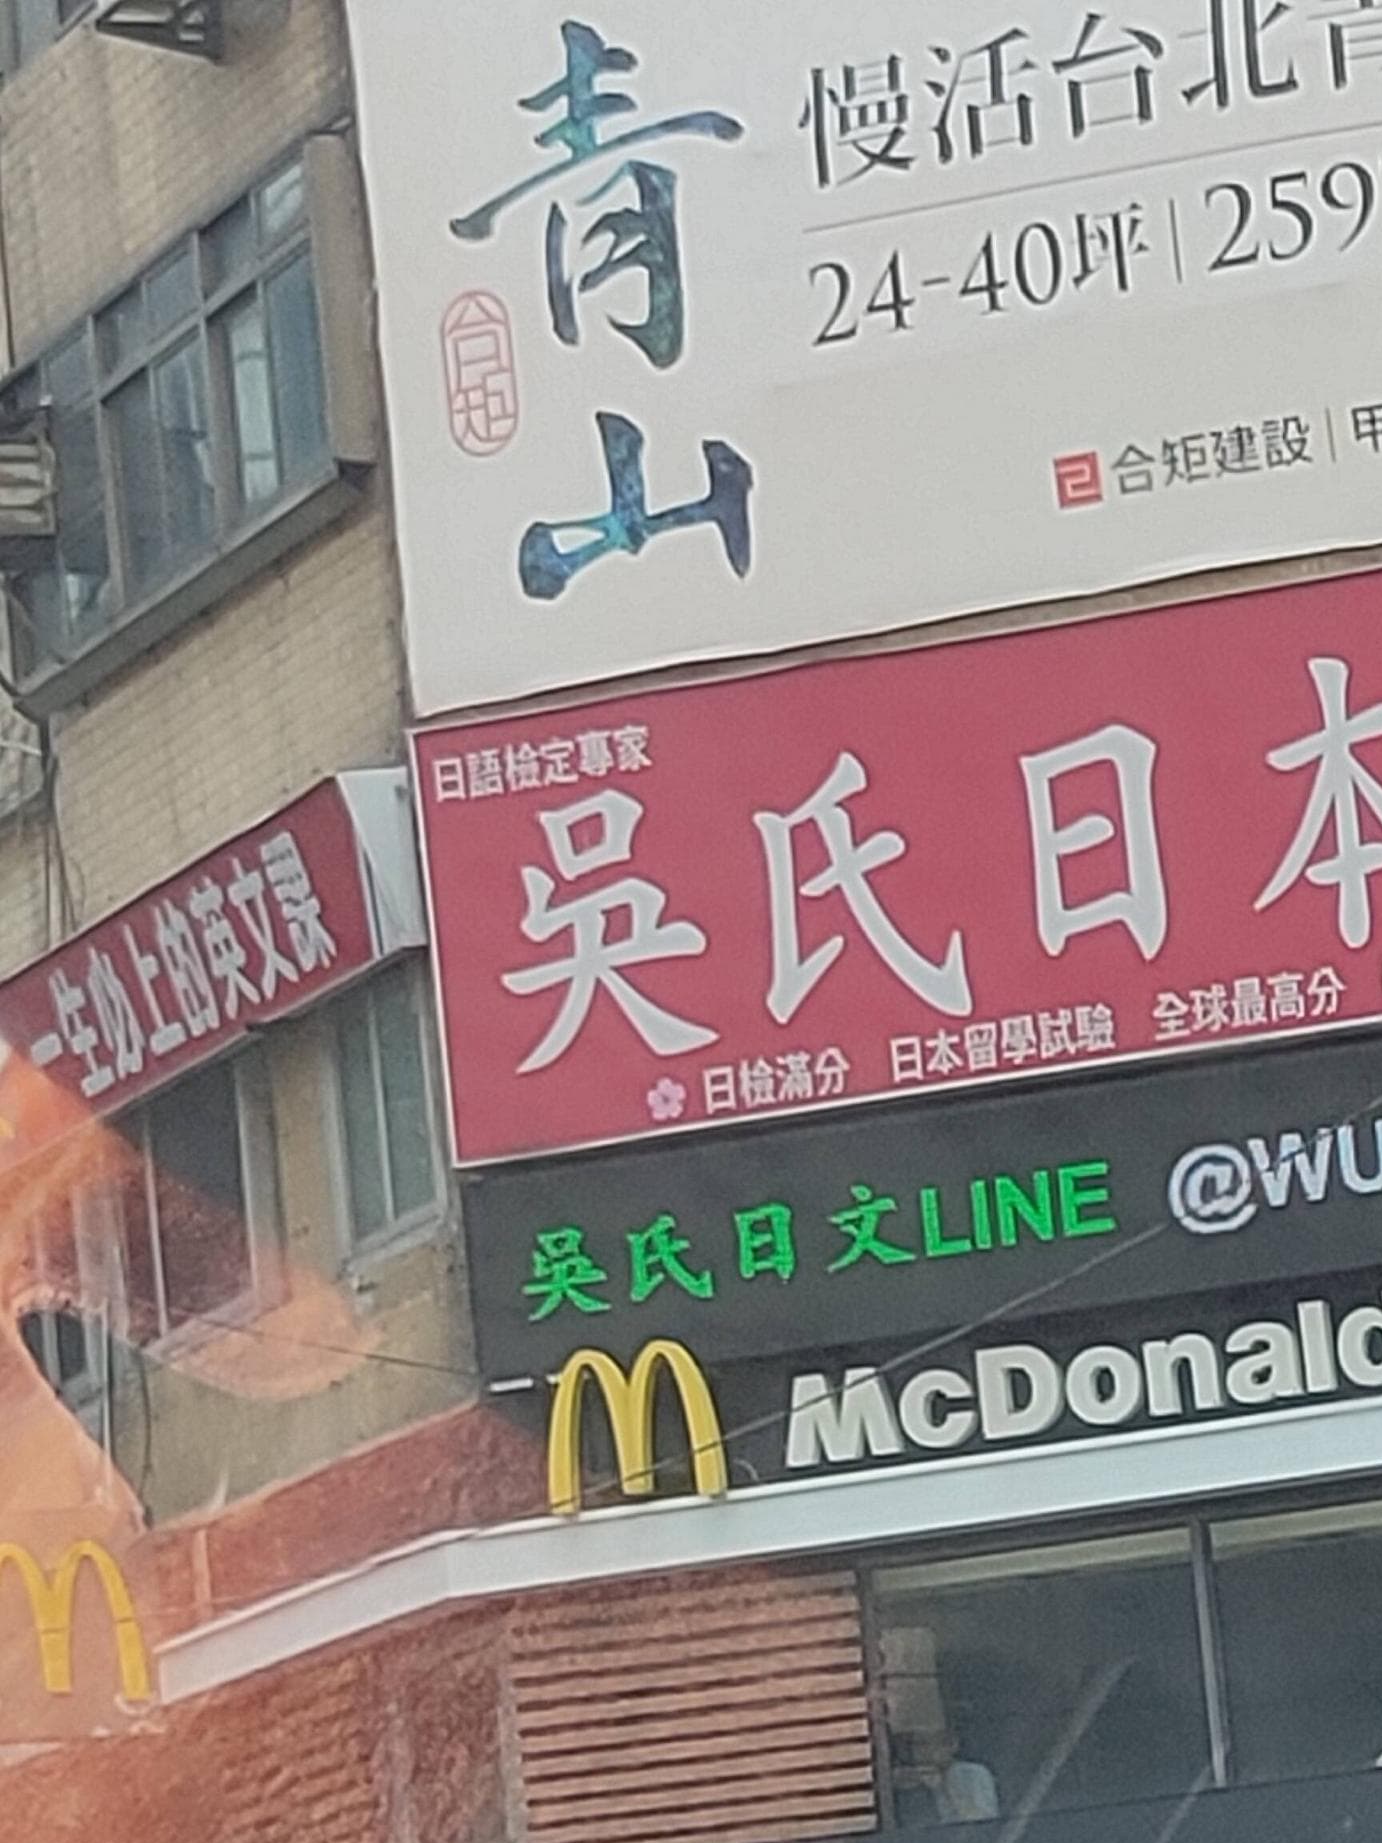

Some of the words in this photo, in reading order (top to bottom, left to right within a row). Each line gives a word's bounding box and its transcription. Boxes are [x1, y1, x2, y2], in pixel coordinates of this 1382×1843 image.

[450, 20, 753, 600] 青山
[809, 202, 1148, 346] 24-40坪
[1110, 415, 1313, 496] 合矩建設
[432, 725, 653, 803] 日語檢定專家
[703, 1046, 851, 1115] 日檢滿分
[889, 1002, 1117, 1083] 日本留學試驗
[1152, 965, 1347, 1043] 全球最高分
